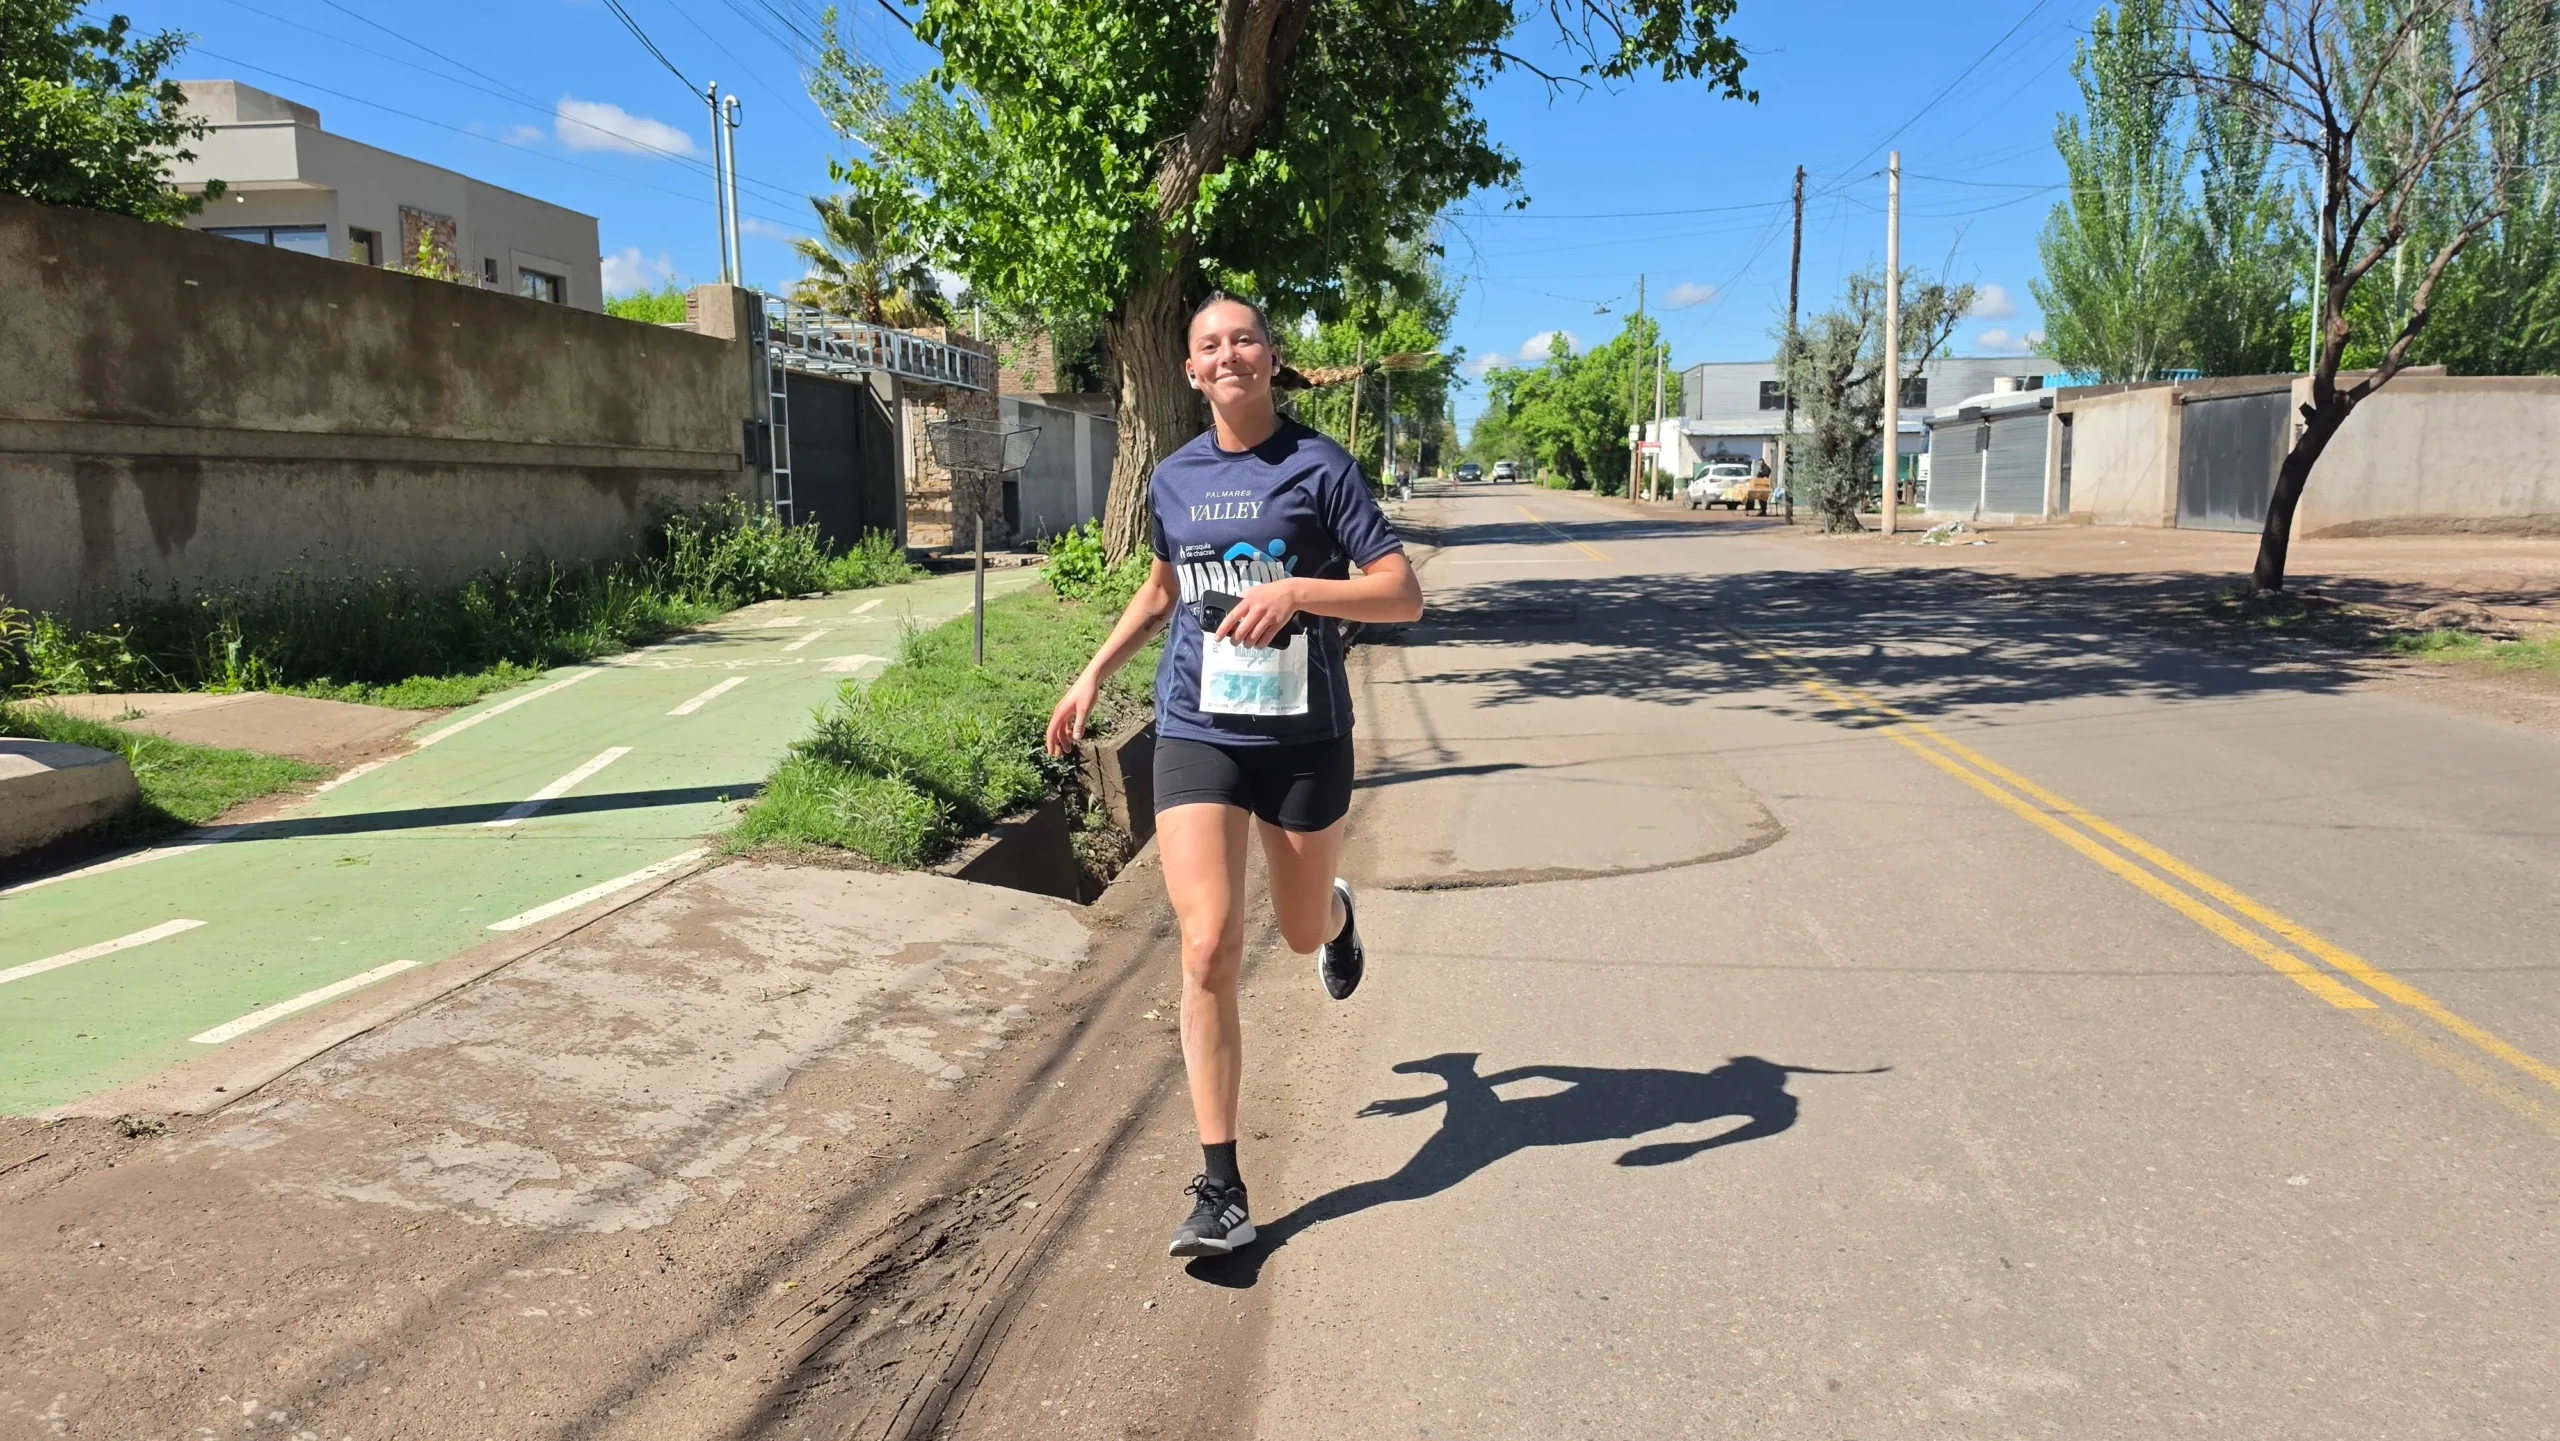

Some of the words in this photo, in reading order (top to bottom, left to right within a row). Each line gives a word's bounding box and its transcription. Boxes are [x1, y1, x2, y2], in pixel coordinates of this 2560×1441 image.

[1206, 490, 1252, 499] PALMARES
[1190, 501, 1264, 522] VALLEY
[1185, 543, 1212, 552] parroquia
[1223, 674, 1284, 701] 374
